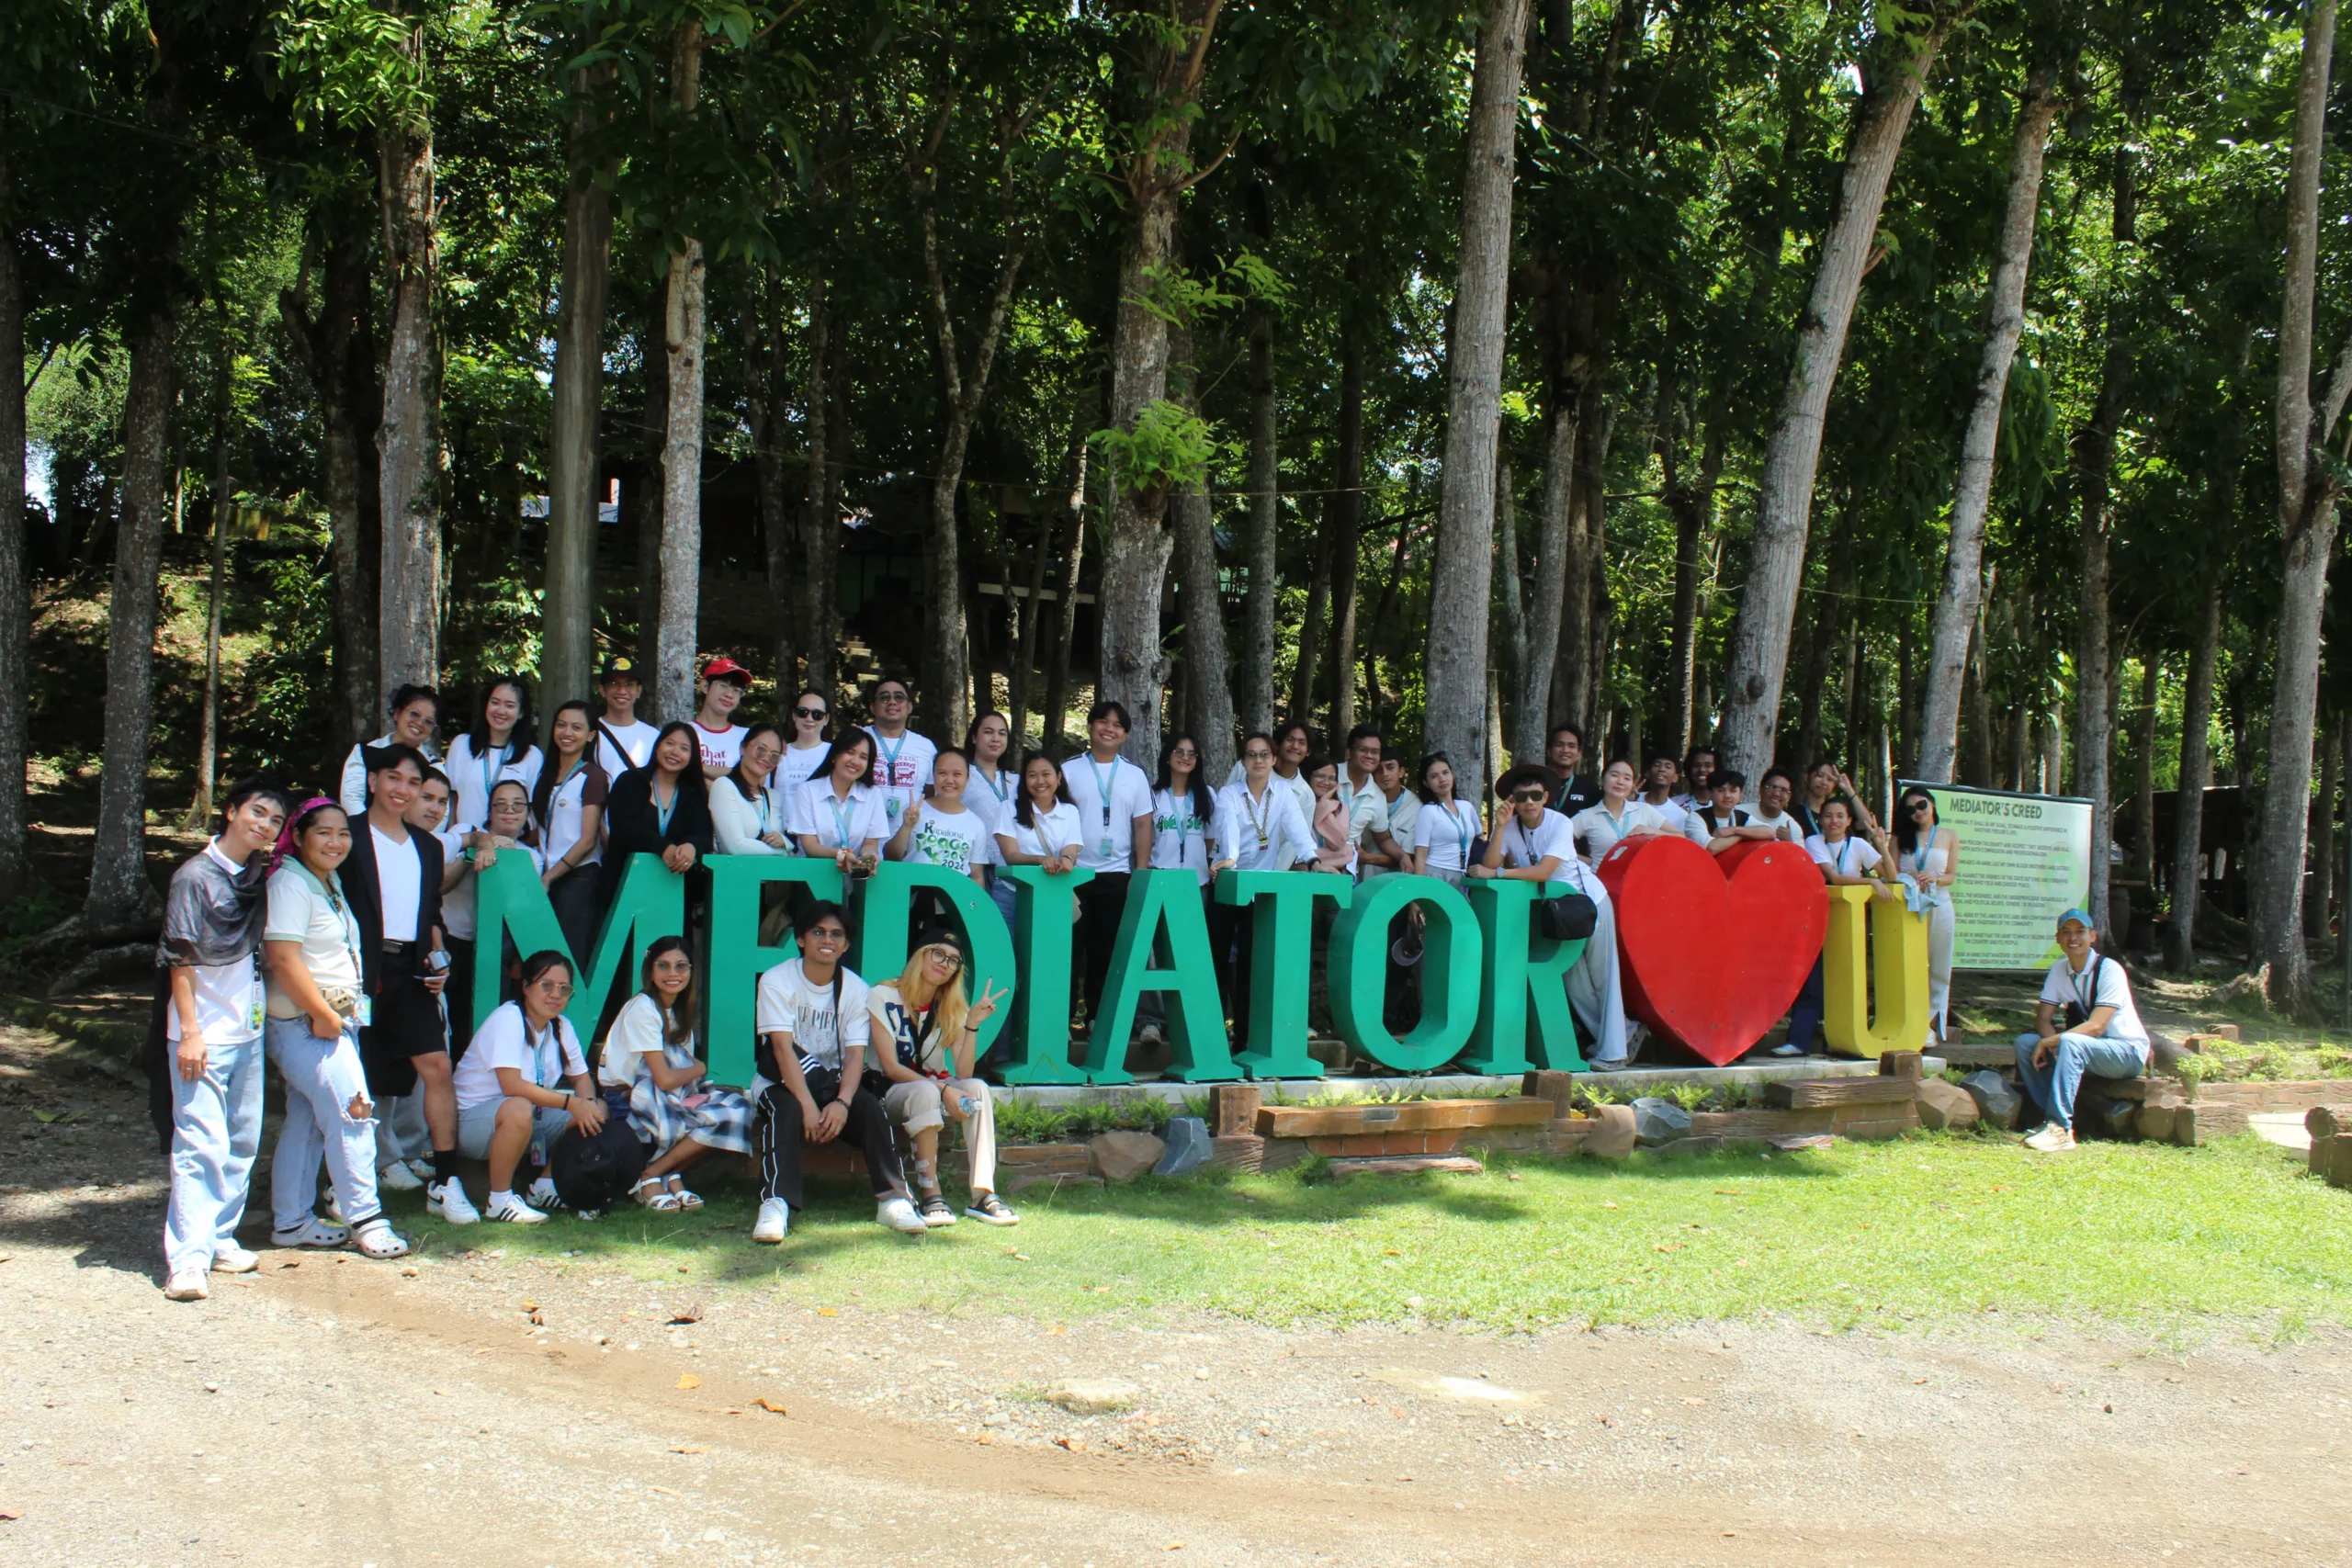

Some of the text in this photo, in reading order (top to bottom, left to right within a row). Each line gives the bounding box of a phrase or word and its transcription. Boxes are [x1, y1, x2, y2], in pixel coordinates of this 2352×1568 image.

[1950, 797, 2042, 819] MEDIATOR'S CREED
[924, 822, 964, 839] Kapalong
[942, 859, 964, 871] 2024
[472, 847, 1929, 1088] MEDIATOR U
